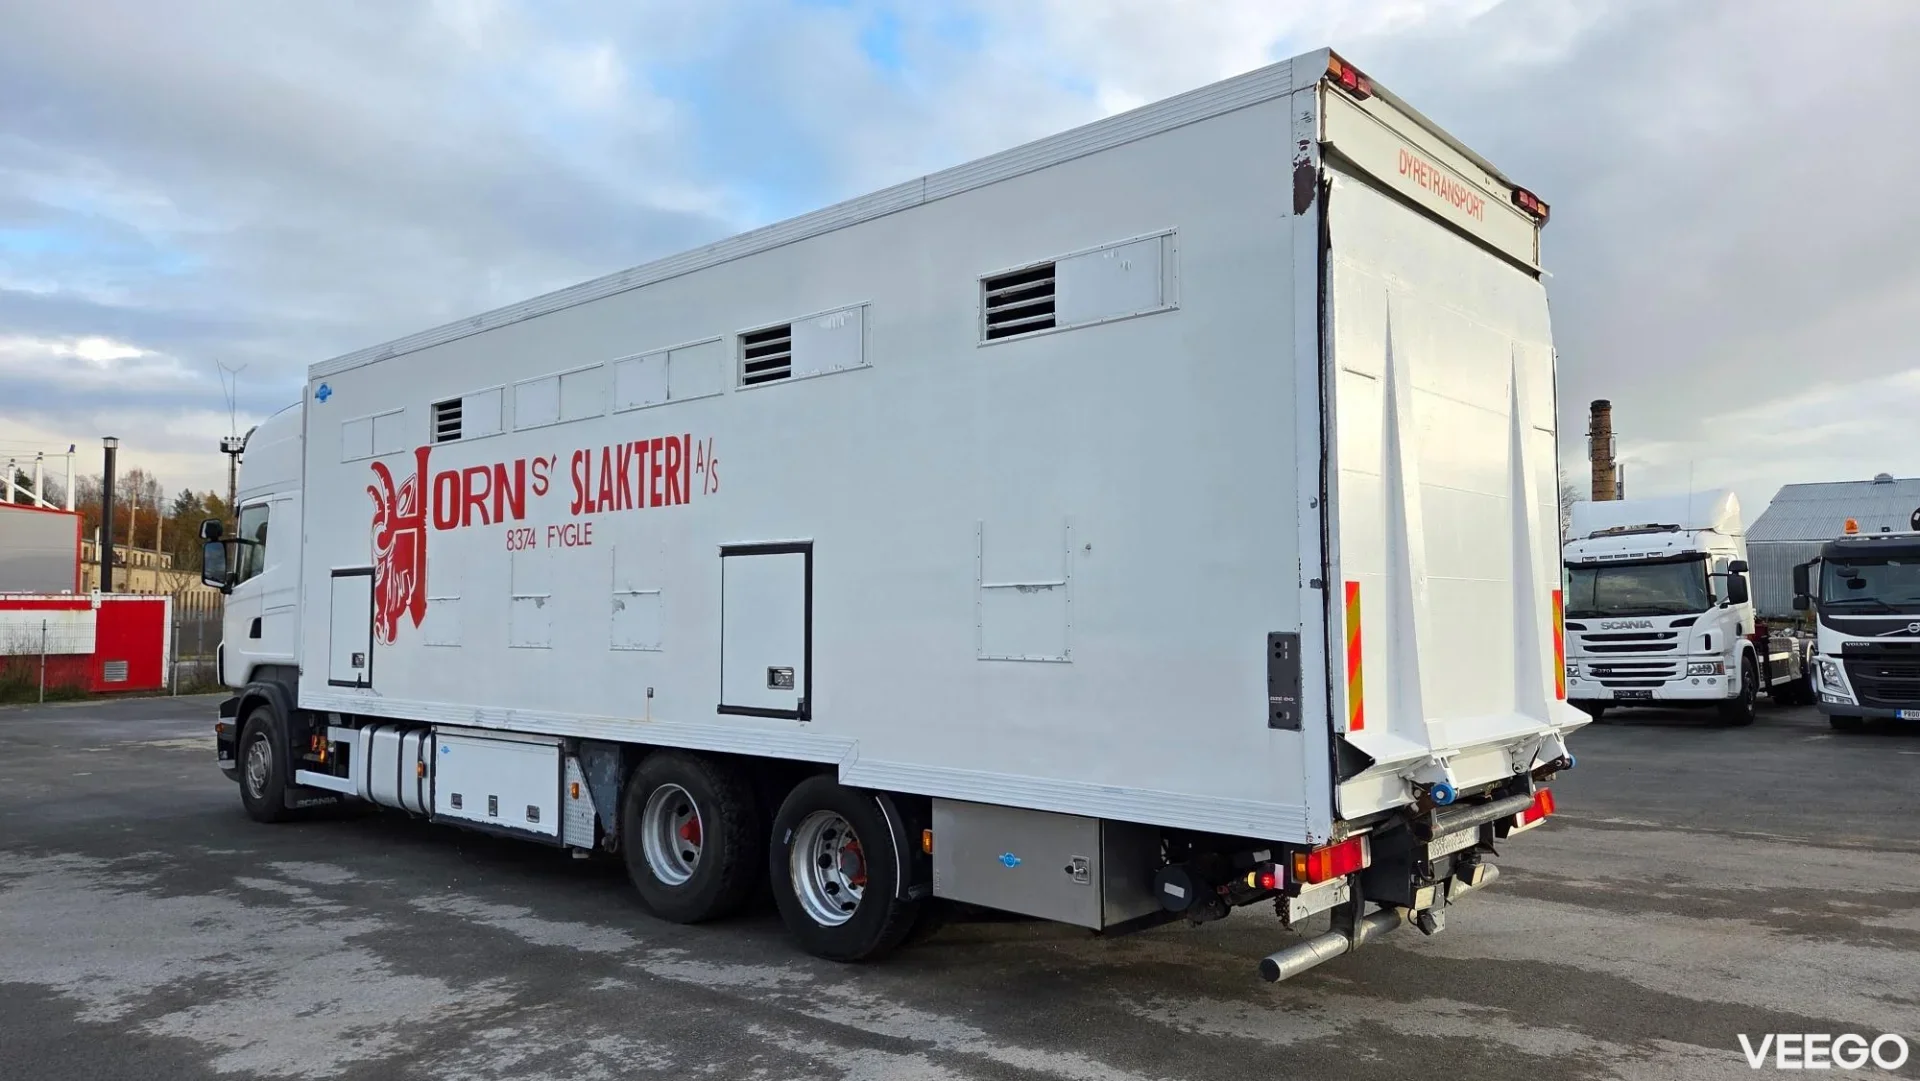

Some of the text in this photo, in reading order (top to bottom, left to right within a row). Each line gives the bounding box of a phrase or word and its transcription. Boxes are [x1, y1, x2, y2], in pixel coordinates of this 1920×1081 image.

[1399, 149, 1485, 222] DYRETRANSPORT
[571, 434, 691, 516] SLAKTERI
[696, 437, 719, 495] A/S
[506, 522, 593, 551] 8374 FYGLE
[1600, 620, 1654, 630] SCANIA
[296, 797, 338, 808] SCANIA
